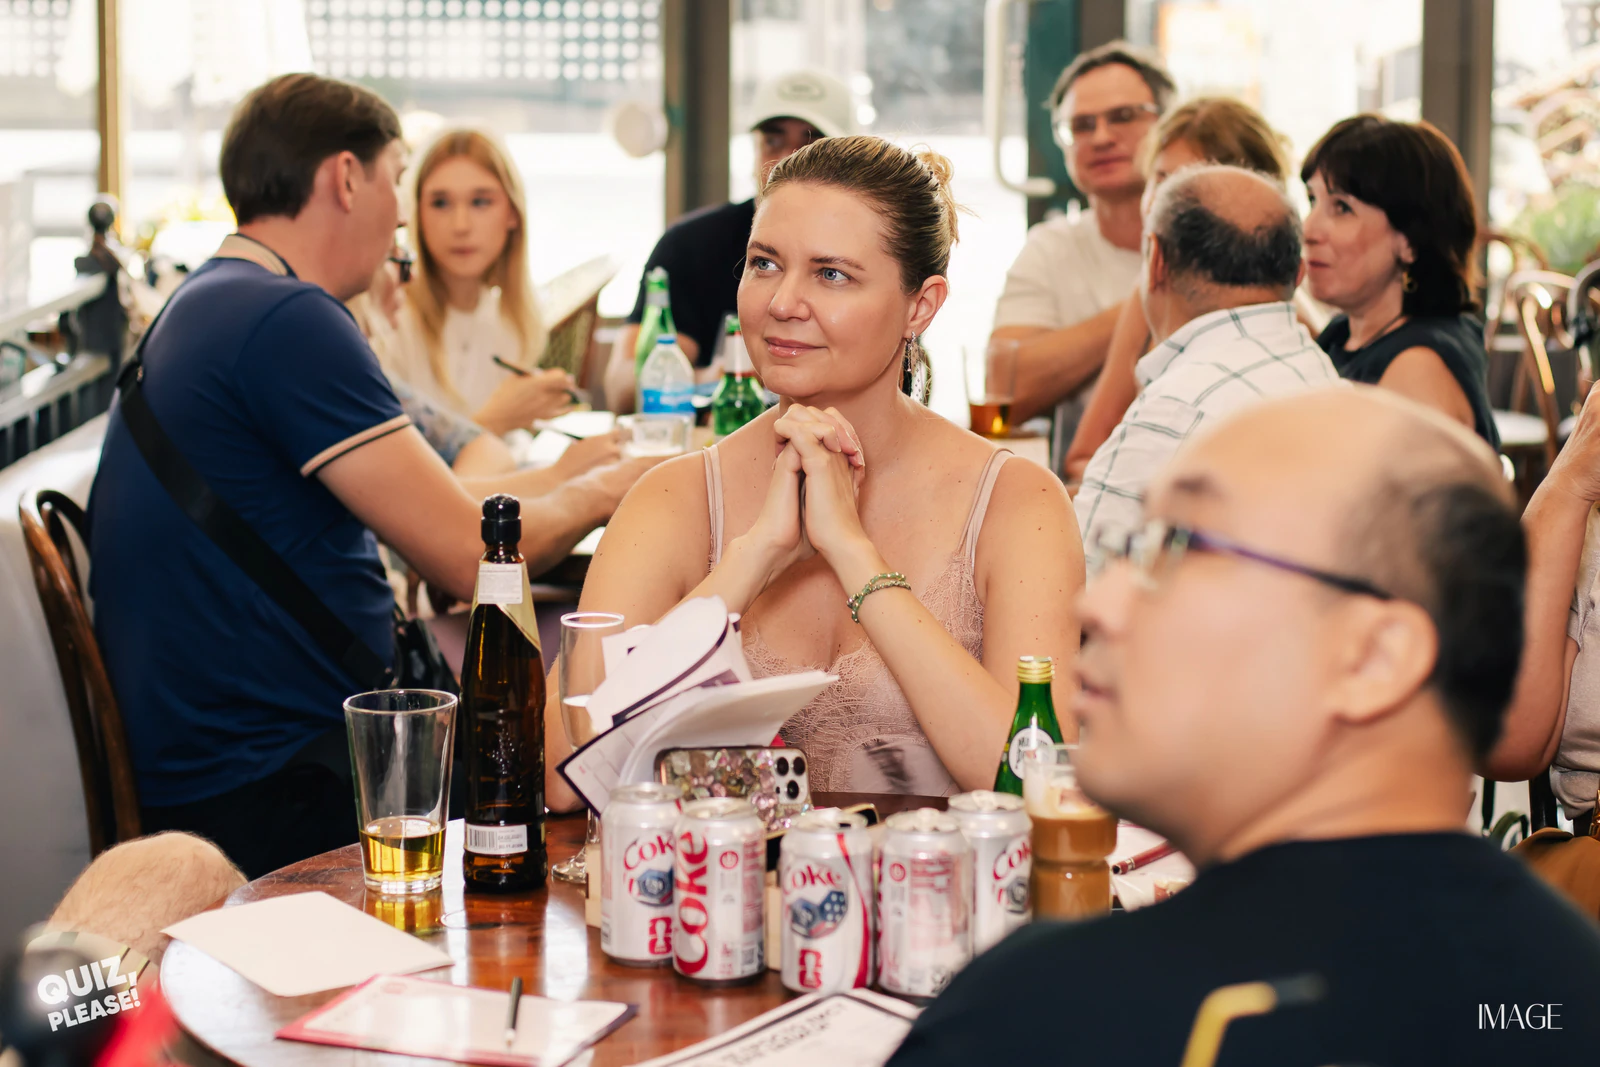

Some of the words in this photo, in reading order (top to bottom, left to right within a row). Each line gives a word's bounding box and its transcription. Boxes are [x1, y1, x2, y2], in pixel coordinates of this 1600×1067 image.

[623, 835, 675, 871] Cok
[993, 841, 1031, 880] Cok
[674, 831, 709, 975] Coke
